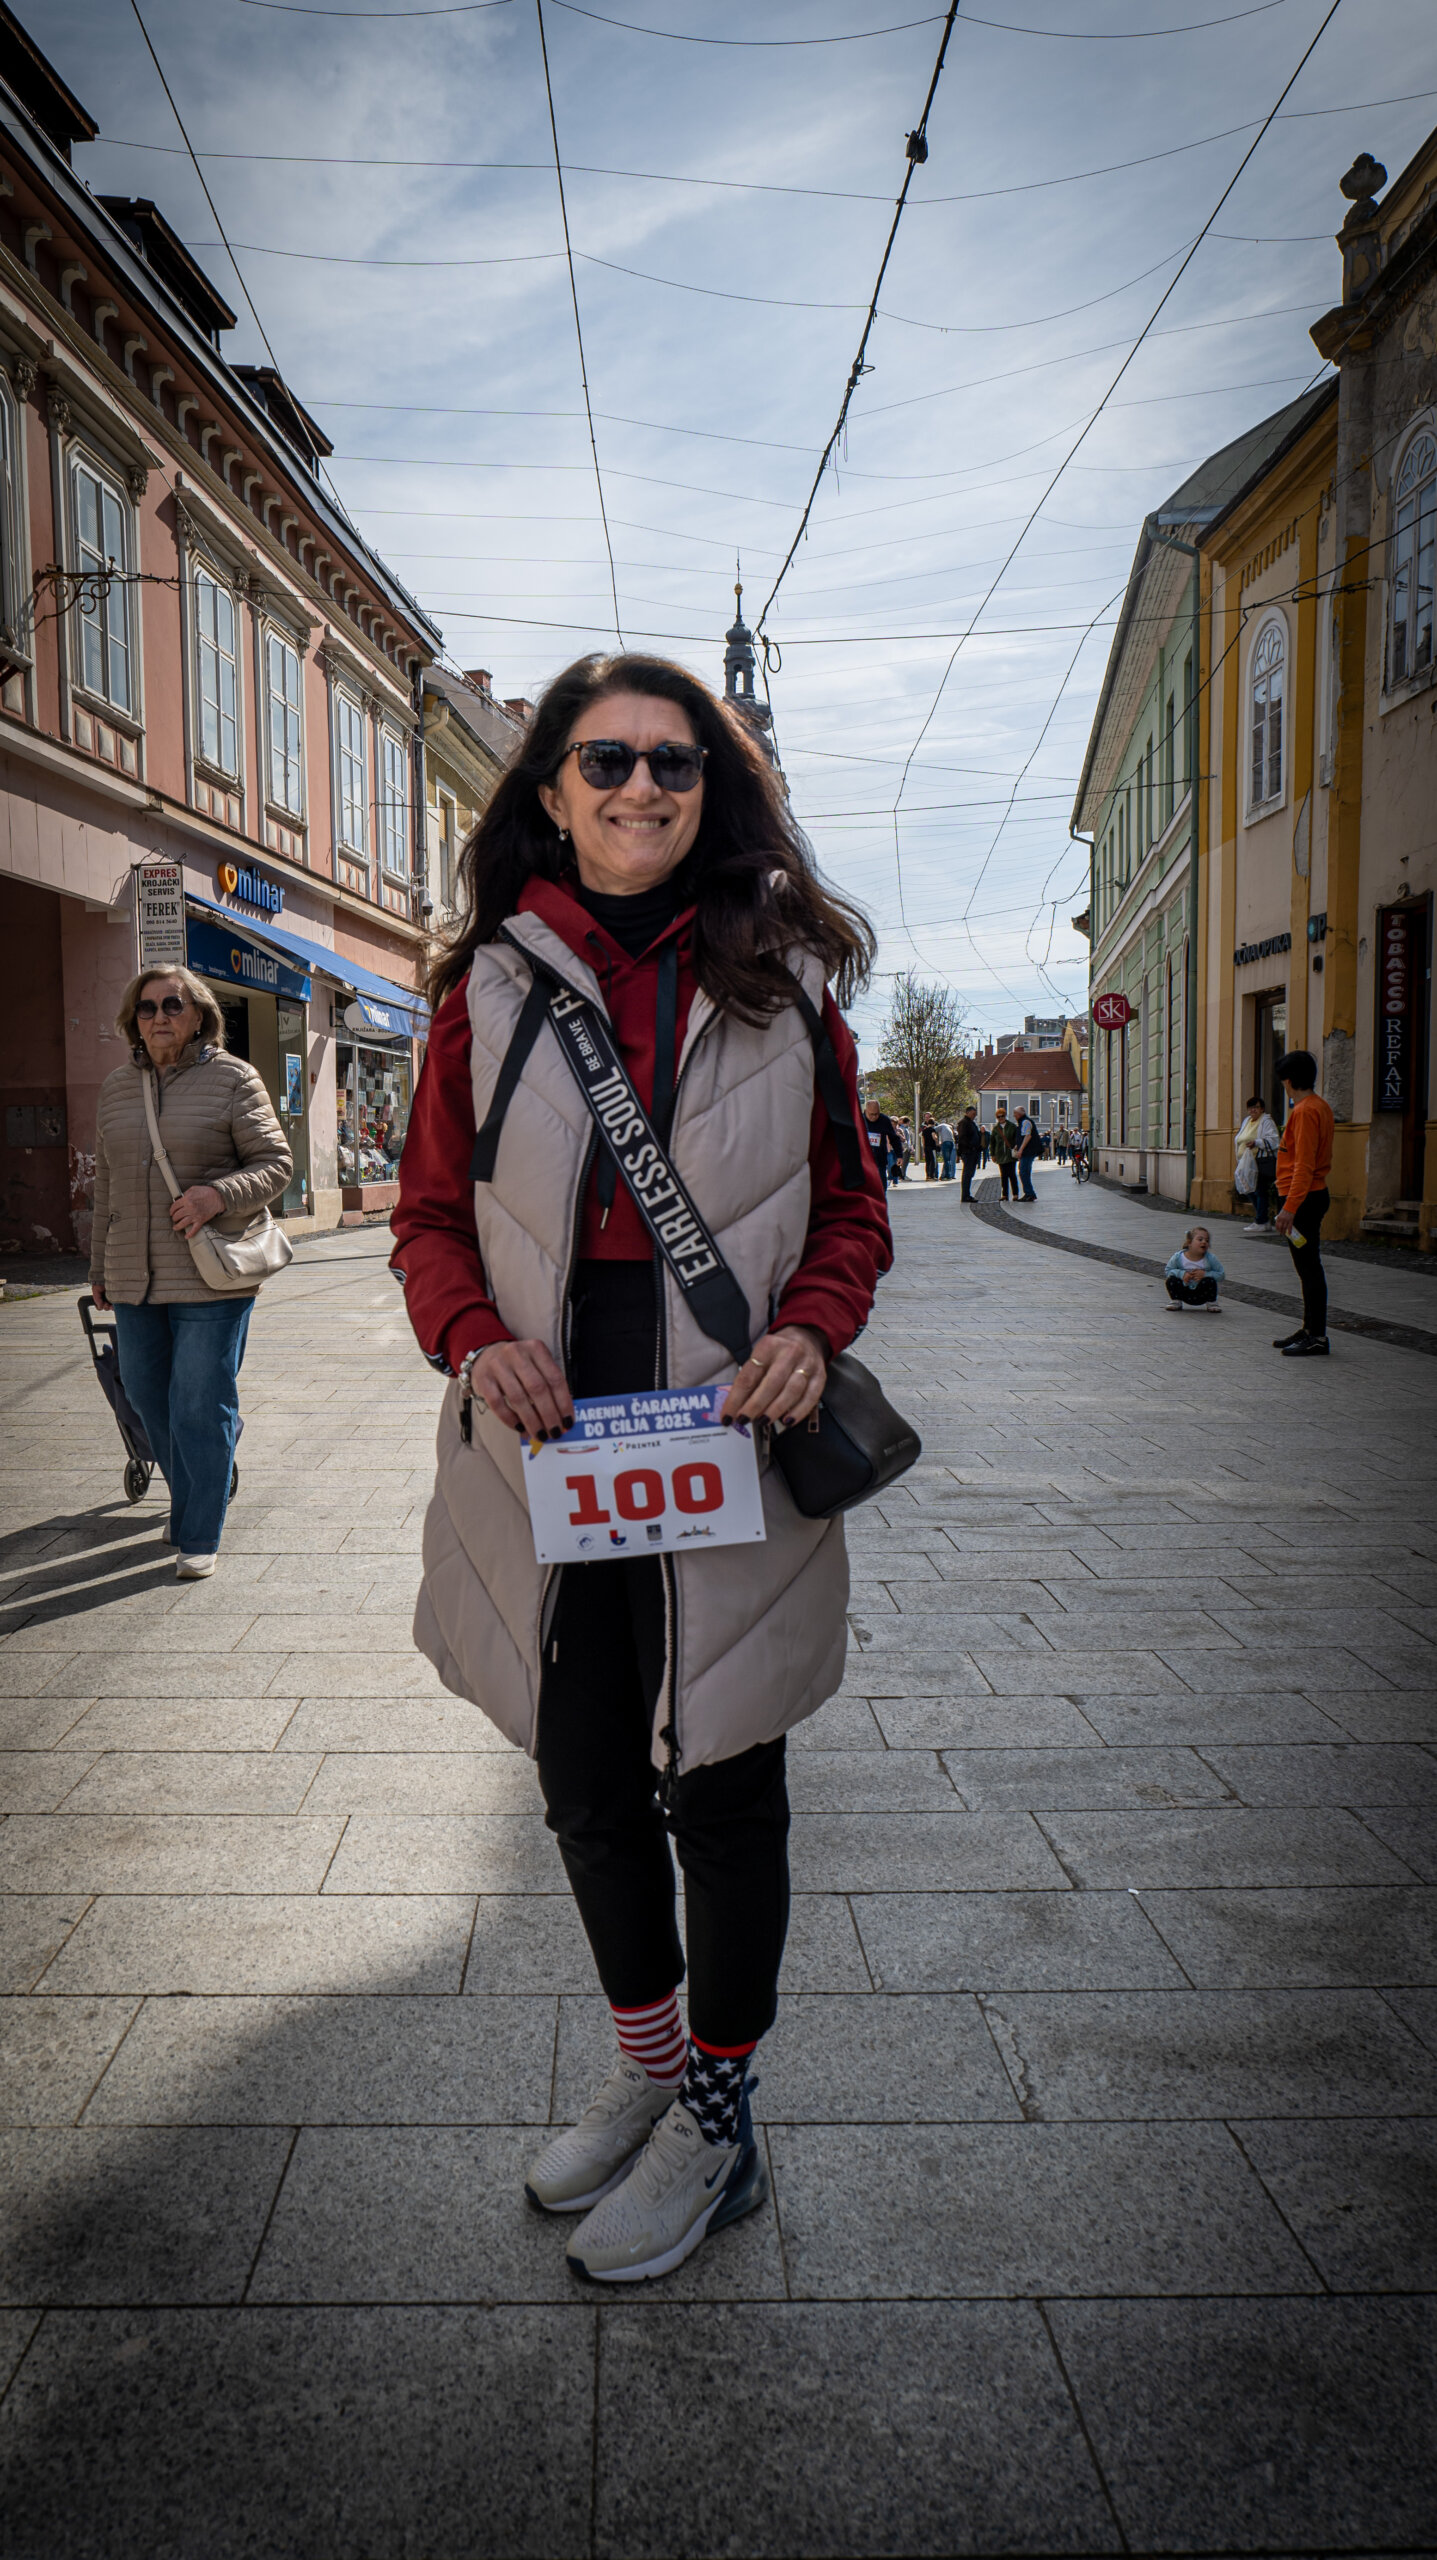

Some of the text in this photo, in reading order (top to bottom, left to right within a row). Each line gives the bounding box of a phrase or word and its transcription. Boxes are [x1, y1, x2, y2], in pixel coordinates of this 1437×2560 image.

[142, 878, 180, 888] KROJAČKI
[144, 868, 177, 879] EXPRES
[238, 867, 286, 913] mlinar
[147, 888, 175, 896] SERVIS
[1259, 932, 1292, 959] OPTIKA
[242, 949, 279, 985] mlinar
[1386, 914, 1406, 1014] TOBACCO
[568, 1019, 601, 1072] BE BRAVE
[1384, 1019, 1403, 1096] REFAN
[588, 1065, 718, 1287] EARLESS SOUL
[631, 1394, 711, 1417] ČARAPAMA
[584, 1412, 696, 1438] DO CILJA 2025.
[566, 1462, 723, 1526] 100
